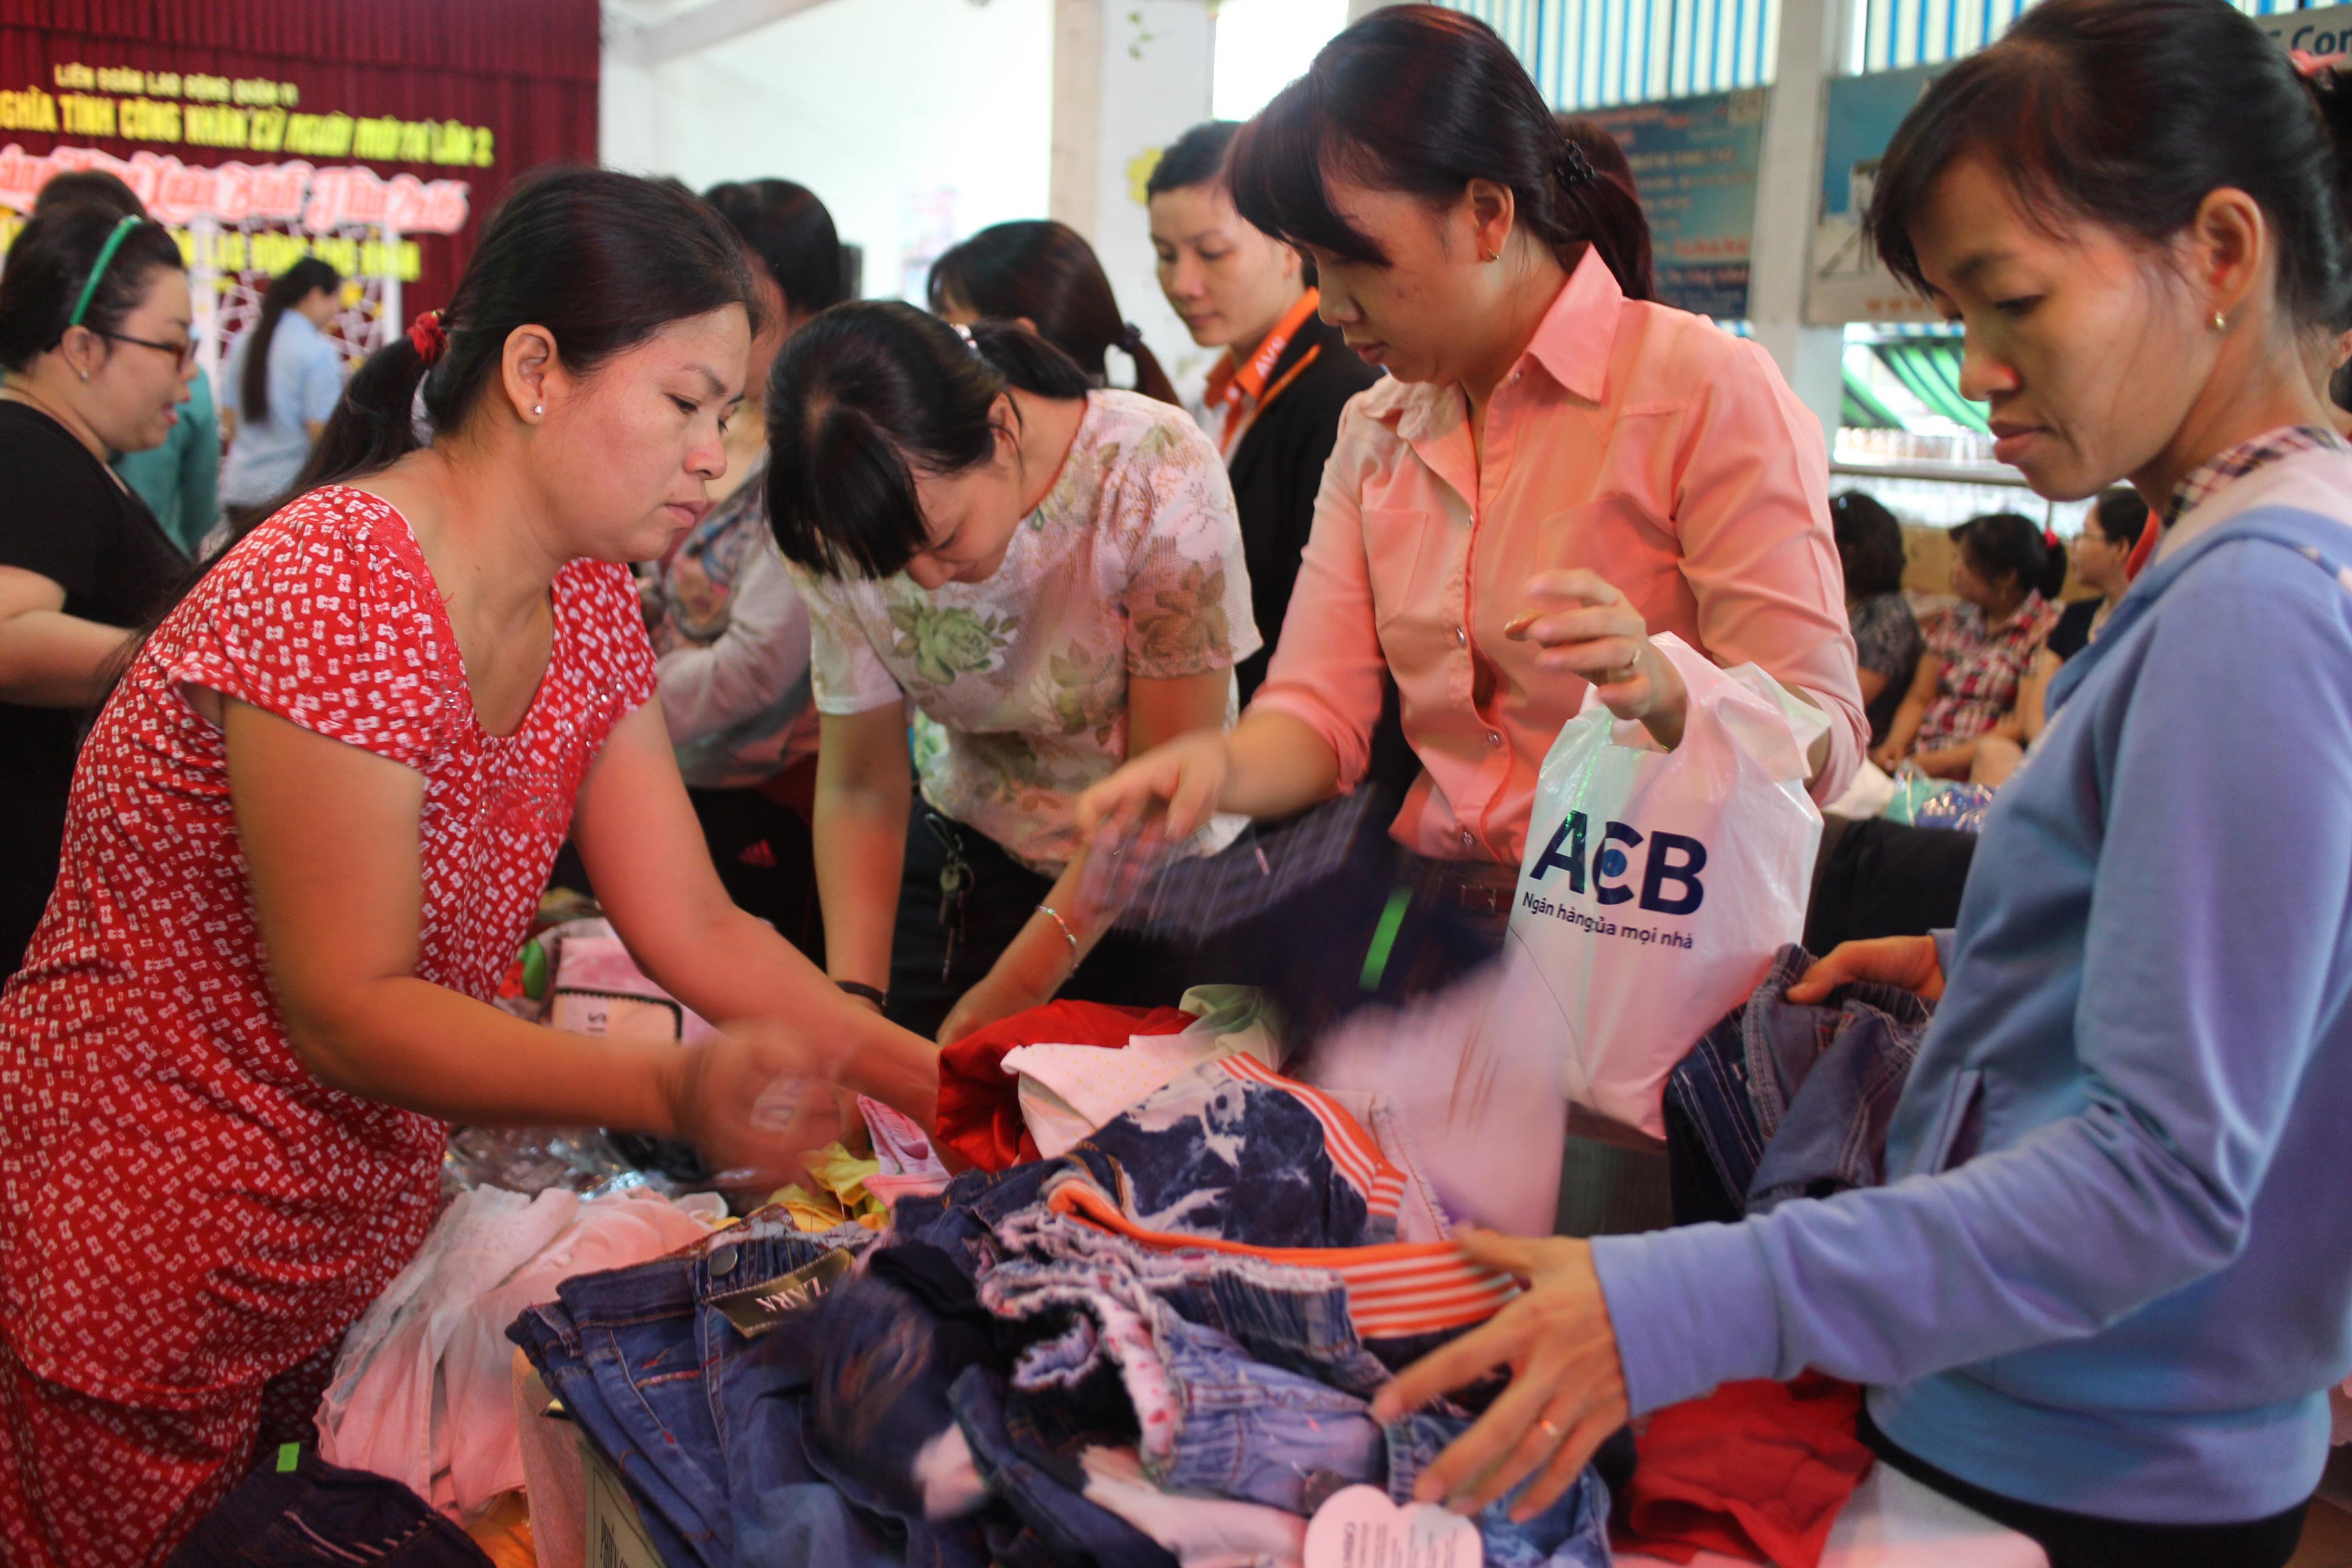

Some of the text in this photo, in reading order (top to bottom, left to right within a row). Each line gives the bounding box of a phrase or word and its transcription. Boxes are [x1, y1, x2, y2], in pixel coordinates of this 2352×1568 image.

[1529, 810, 1707, 915] ACB
[1522, 892, 1554, 916] Ngân
[1556, 904, 1593, 933] hàng
[1593, 916, 1616, 936] ủa
[1621, 926, 1658, 945] mọi
